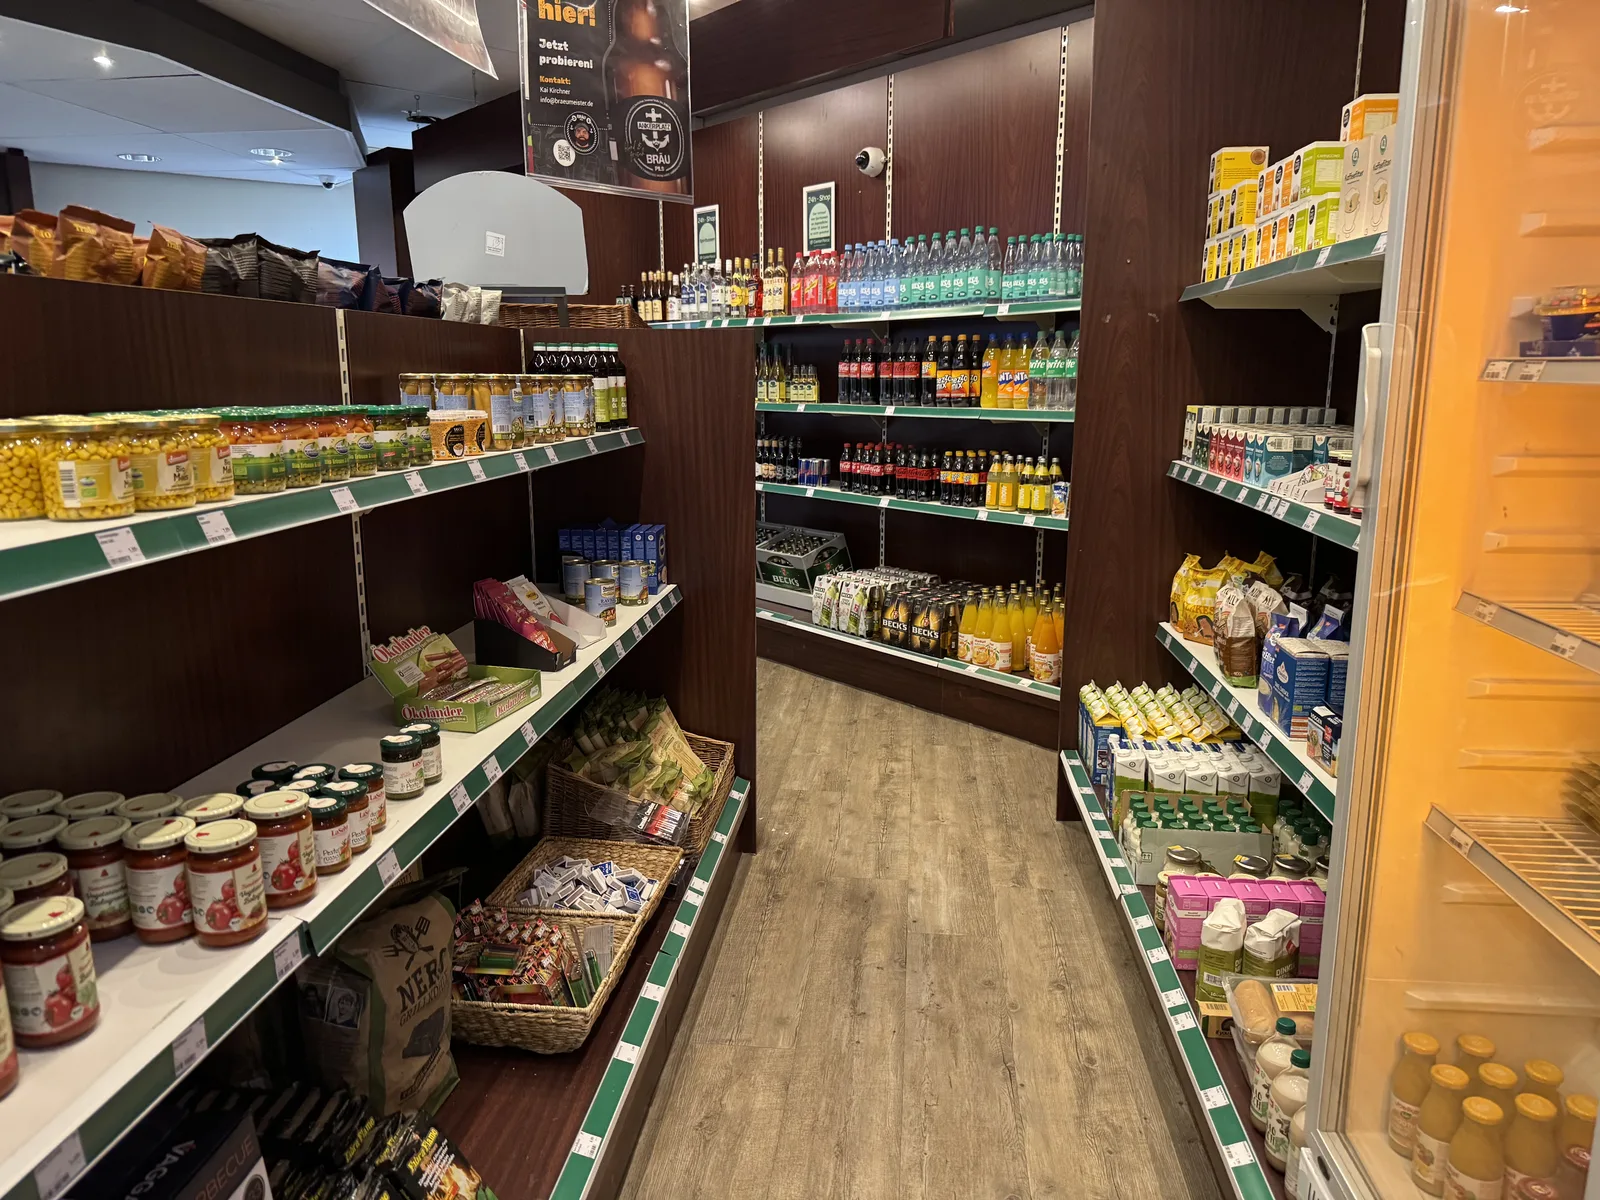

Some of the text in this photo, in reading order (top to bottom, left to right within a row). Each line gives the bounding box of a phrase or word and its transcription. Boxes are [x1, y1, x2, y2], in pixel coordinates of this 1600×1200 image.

[537, 0, 596, 27] hier!
[538, 38, 569, 52] Jetzt
[539, 55, 594, 69] probieren!
[539, 75, 571, 86] Kontakt:
[539, 86, 571, 96] Kai Kirchner
[175, 465, 185, 473] Bio
